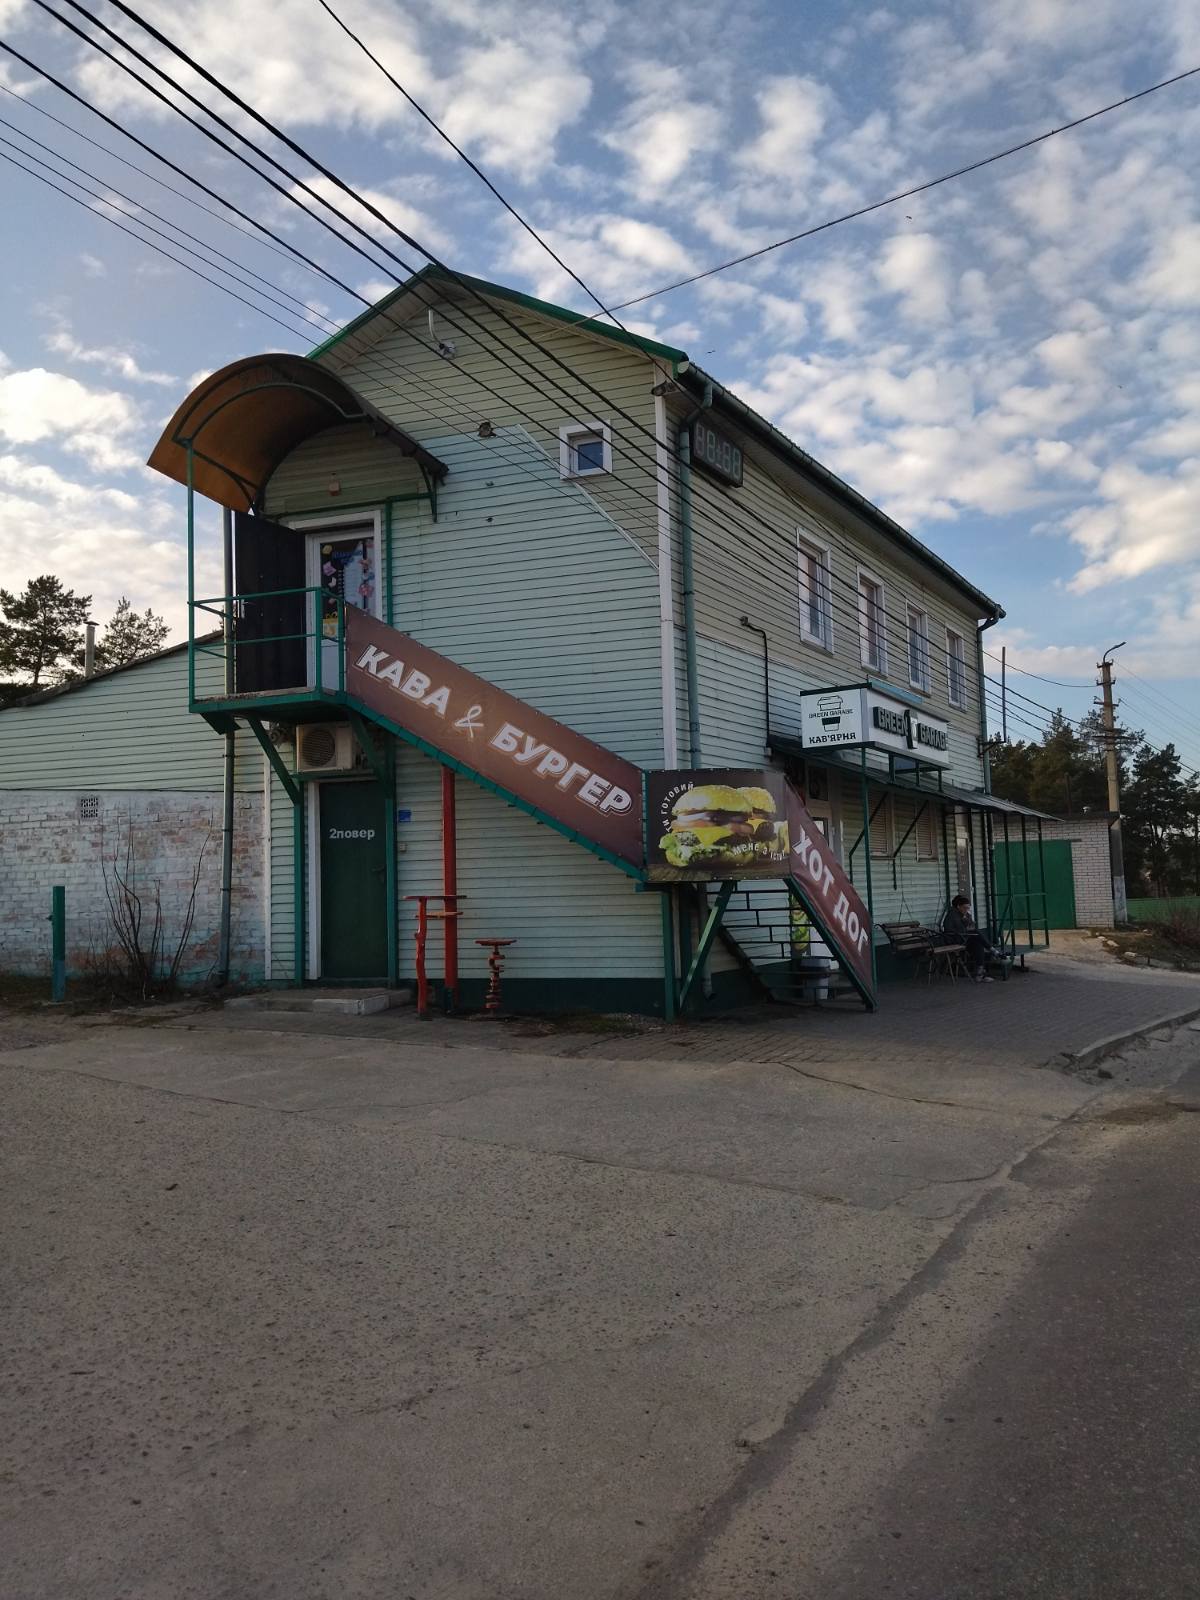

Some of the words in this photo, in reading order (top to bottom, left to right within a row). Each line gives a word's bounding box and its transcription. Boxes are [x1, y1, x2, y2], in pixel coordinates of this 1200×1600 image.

[353, 644, 451, 717] КАВА
[454, 705, 484, 738] &
[490, 722, 633, 815] БУРГЕР
[808, 710, 829, 719] GREEN
[874, 706, 910, 737] GREEN
[809, 732, 857, 744] КАВ'ЯРНЯ
[660, 781, 694, 815] ГОТОВИЙ
[329, 828, 376, 840] 2повер
[792, 824, 835, 897] ХОТ
[833, 891, 869, 952] ДОГ
